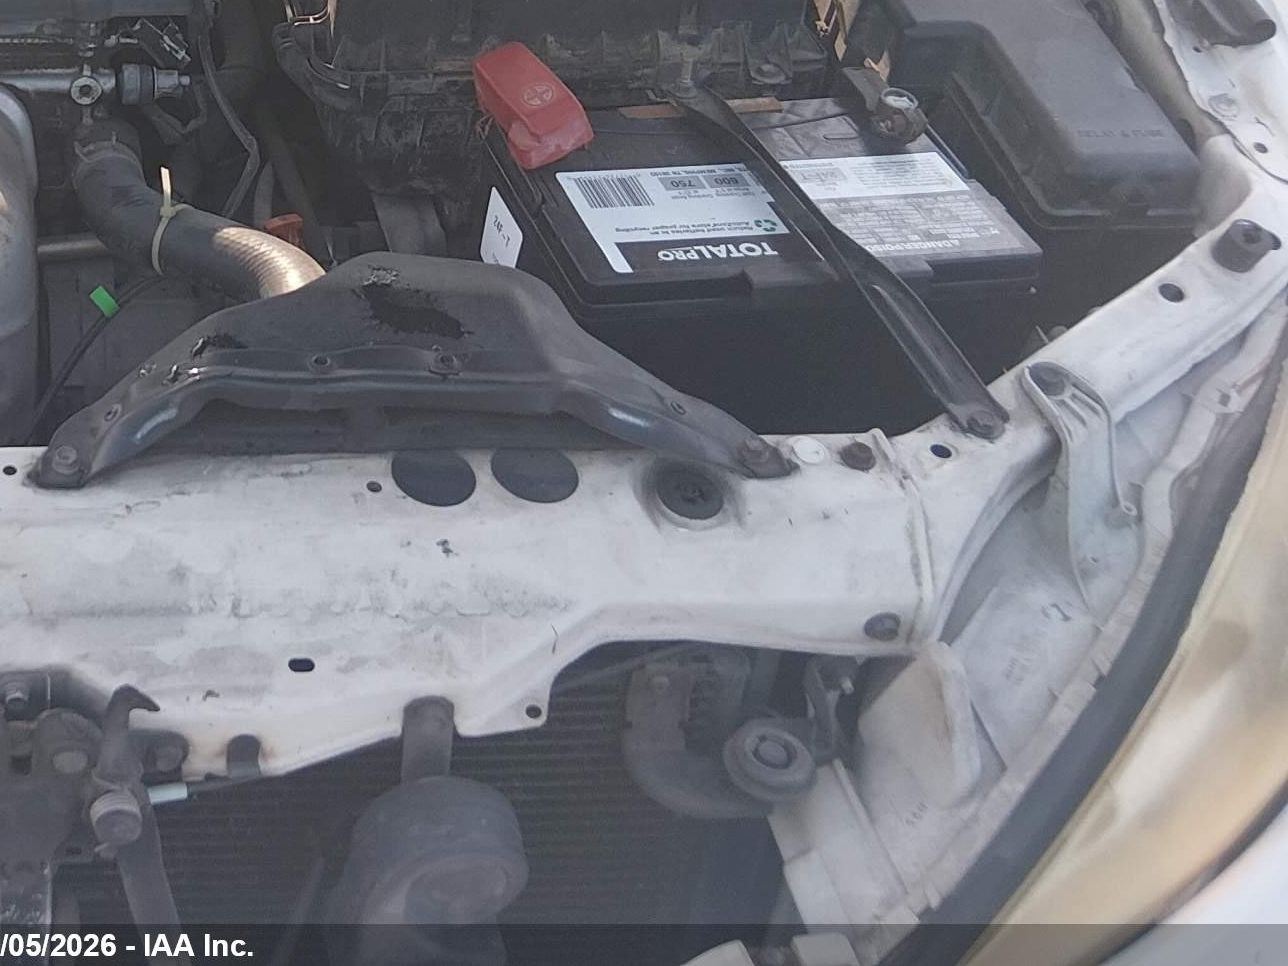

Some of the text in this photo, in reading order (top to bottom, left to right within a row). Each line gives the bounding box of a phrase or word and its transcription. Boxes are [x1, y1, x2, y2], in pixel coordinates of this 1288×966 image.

[671, 179, 696, 188] 750
[651, 223, 677, 231] proper
[657, 241, 779, 262] TOTALPRO
